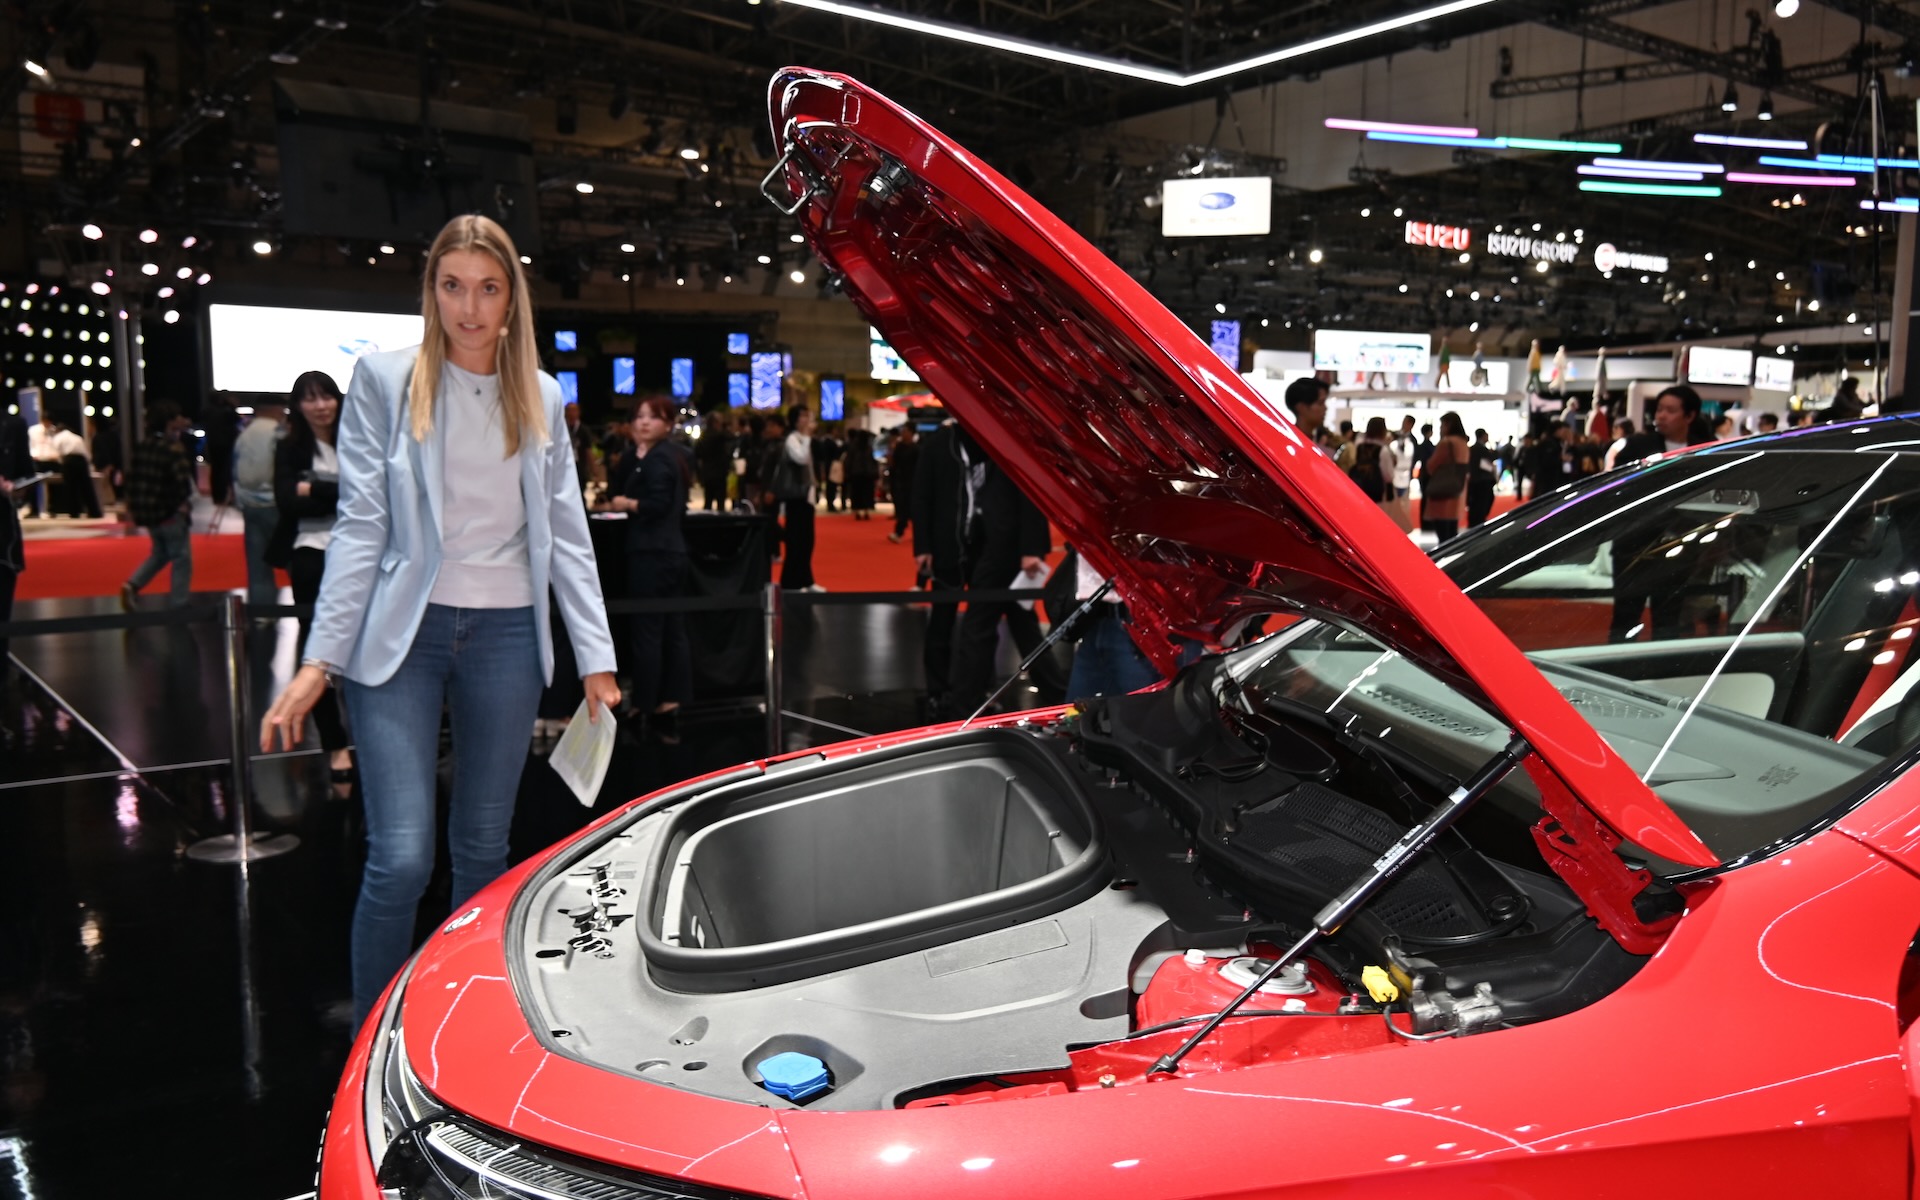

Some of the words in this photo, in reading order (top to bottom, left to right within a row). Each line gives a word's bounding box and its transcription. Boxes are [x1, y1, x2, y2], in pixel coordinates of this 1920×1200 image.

[1405, 220, 1470, 251] ISUZU
[1488, 232, 1532, 258] ISUZU
[1531, 239, 1579, 263] GROUP
